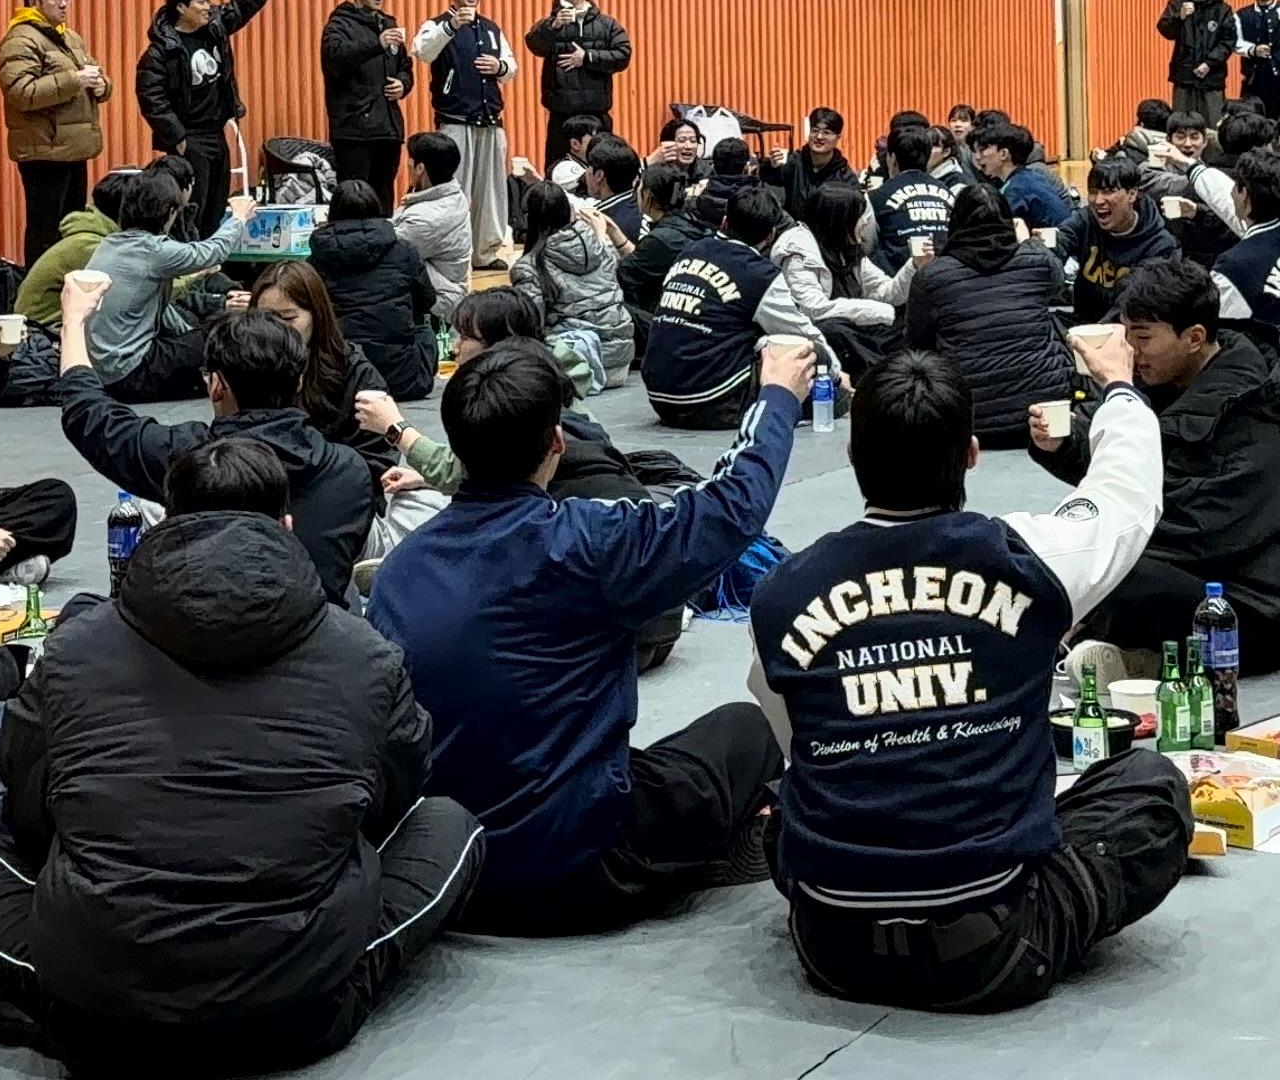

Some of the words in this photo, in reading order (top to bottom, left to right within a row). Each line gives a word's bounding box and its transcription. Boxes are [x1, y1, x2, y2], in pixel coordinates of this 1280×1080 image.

[660, 291, 702, 316] UNIV.
[780, 565, 1033, 671] INCHEON
[835, 634, 972, 670] NATIONAL
[841, 660, 987, 717] UNIV.
[810, 735, 861, 757] Division
[863, 733, 880, 754] of
[881, 727, 932, 748] Health
[936, 723, 949, 740] &
[951, 715, 1023, 738] Kinesiology
